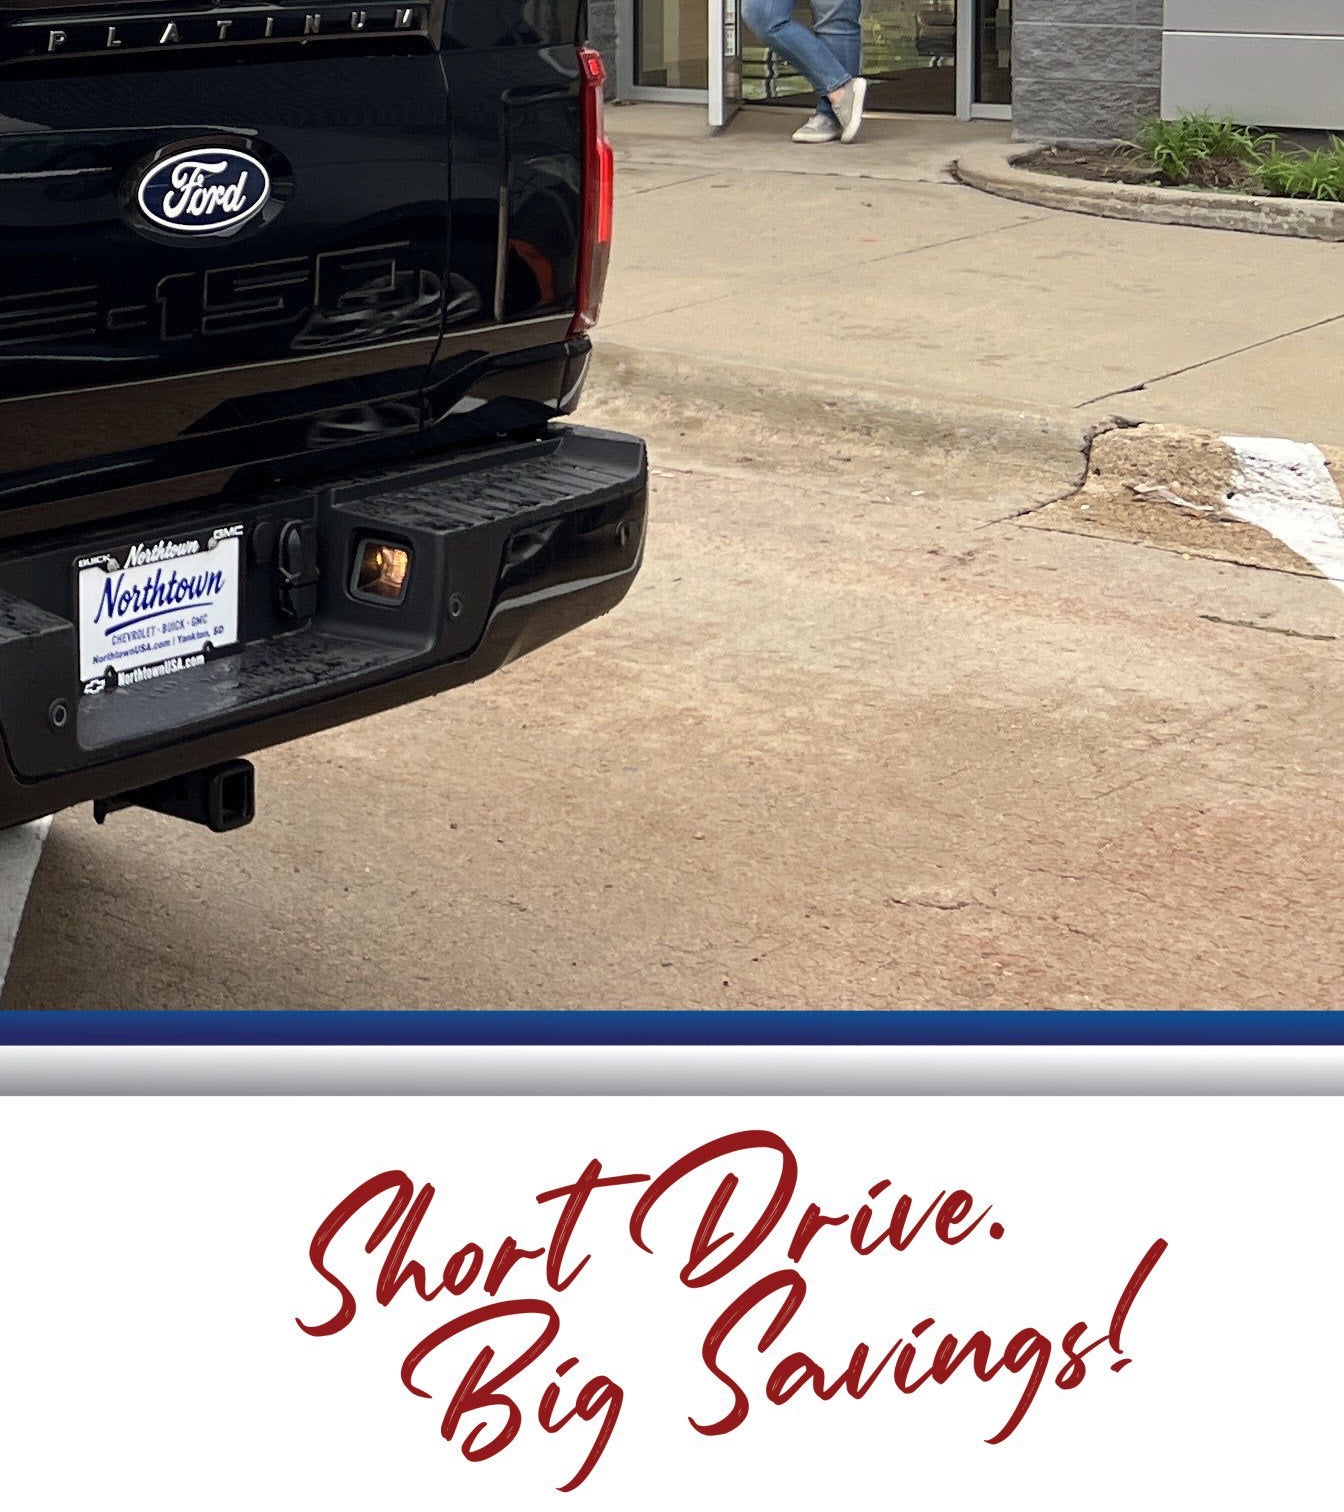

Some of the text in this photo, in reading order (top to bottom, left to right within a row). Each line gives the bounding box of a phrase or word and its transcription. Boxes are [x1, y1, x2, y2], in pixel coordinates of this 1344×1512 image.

[48, 7, 412, 53] PLATINUM
[163, 160, 250, 217] Ford
[214, 525, 243, 539] GMC
[79, 554, 110, 568] BUICK
[124, 541, 199, 569] Northtown
[95, 569, 225, 623] Northtown
[112, 614, 208, 645] CHEVROLET BUICK GMC
[214, 625, 224, 635] SD
[118, 655, 205, 686] NorthtownUSA.com
